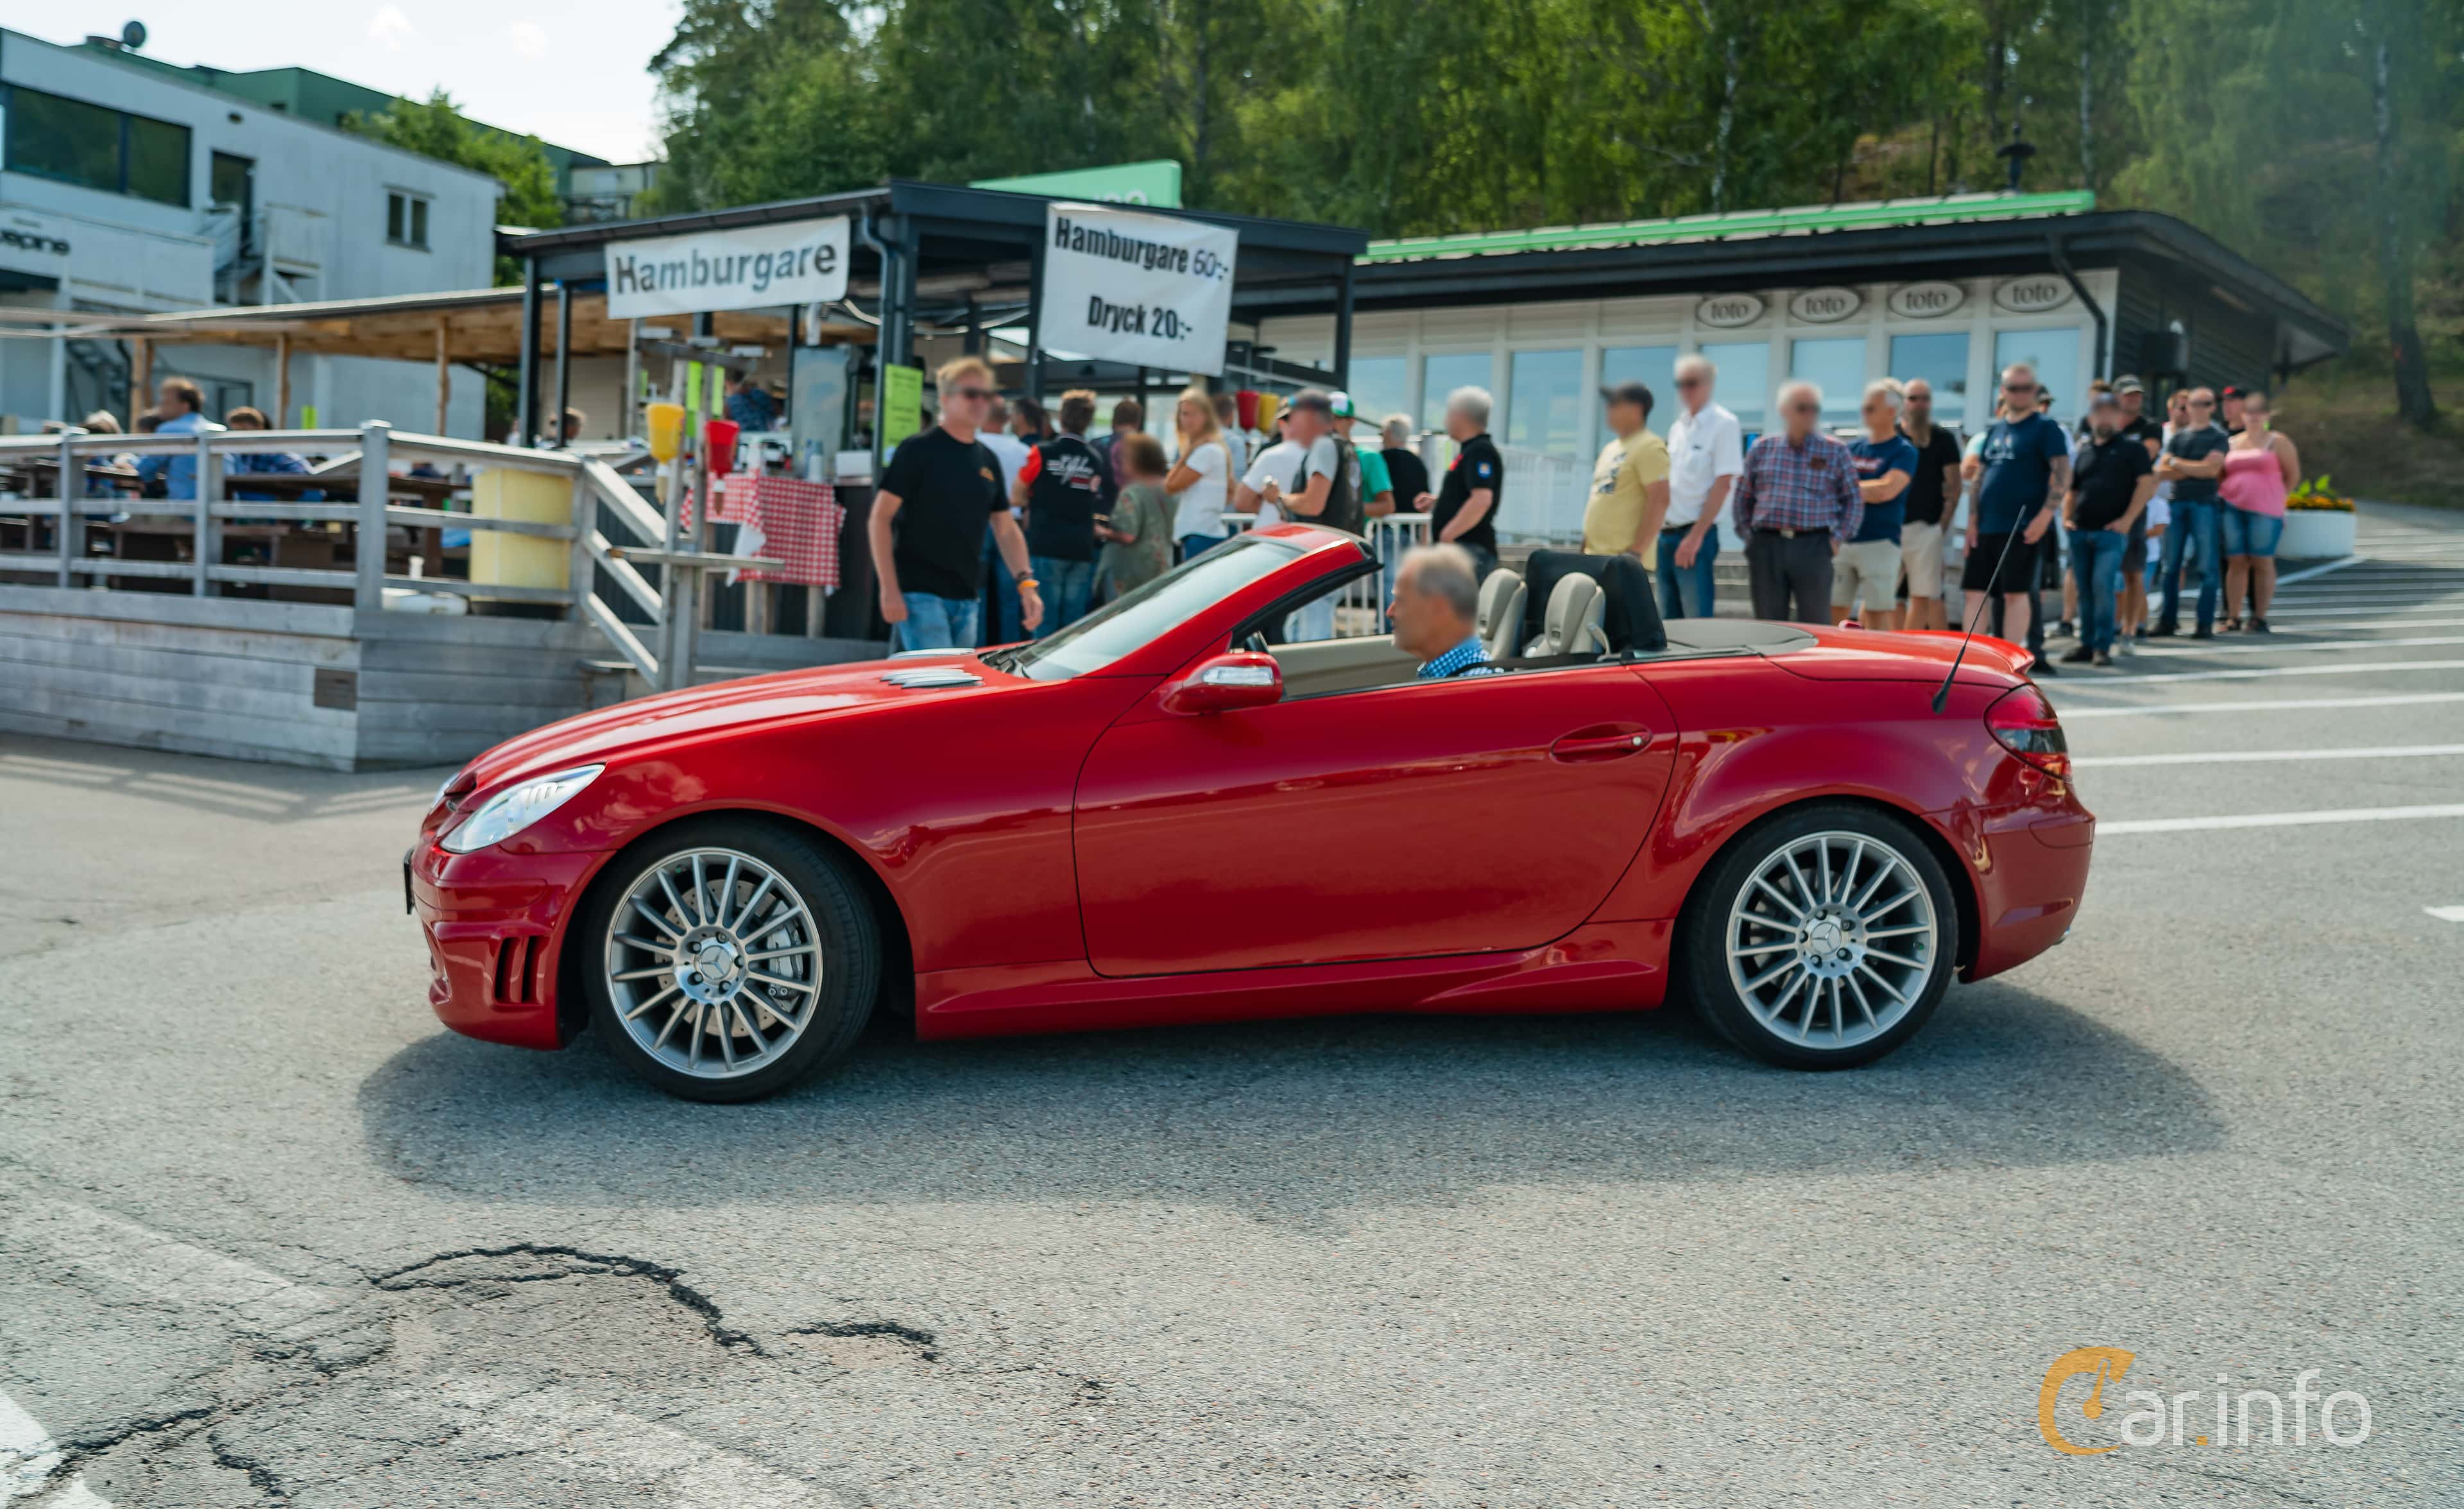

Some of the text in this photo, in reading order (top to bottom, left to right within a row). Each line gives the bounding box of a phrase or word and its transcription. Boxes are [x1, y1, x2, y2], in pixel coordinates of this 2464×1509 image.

[1055, 216, 1190, 272] Hamburgare
[615, 243, 837, 293] Hamburgare
[1906, 290, 1948, 310] toto
[2012, 284, 2058, 304] toto
[1711, 302, 1750, 320] toto
[1805, 296, 1845, 315] toto
[1087, 295, 1193, 341] Dryck 20:-
